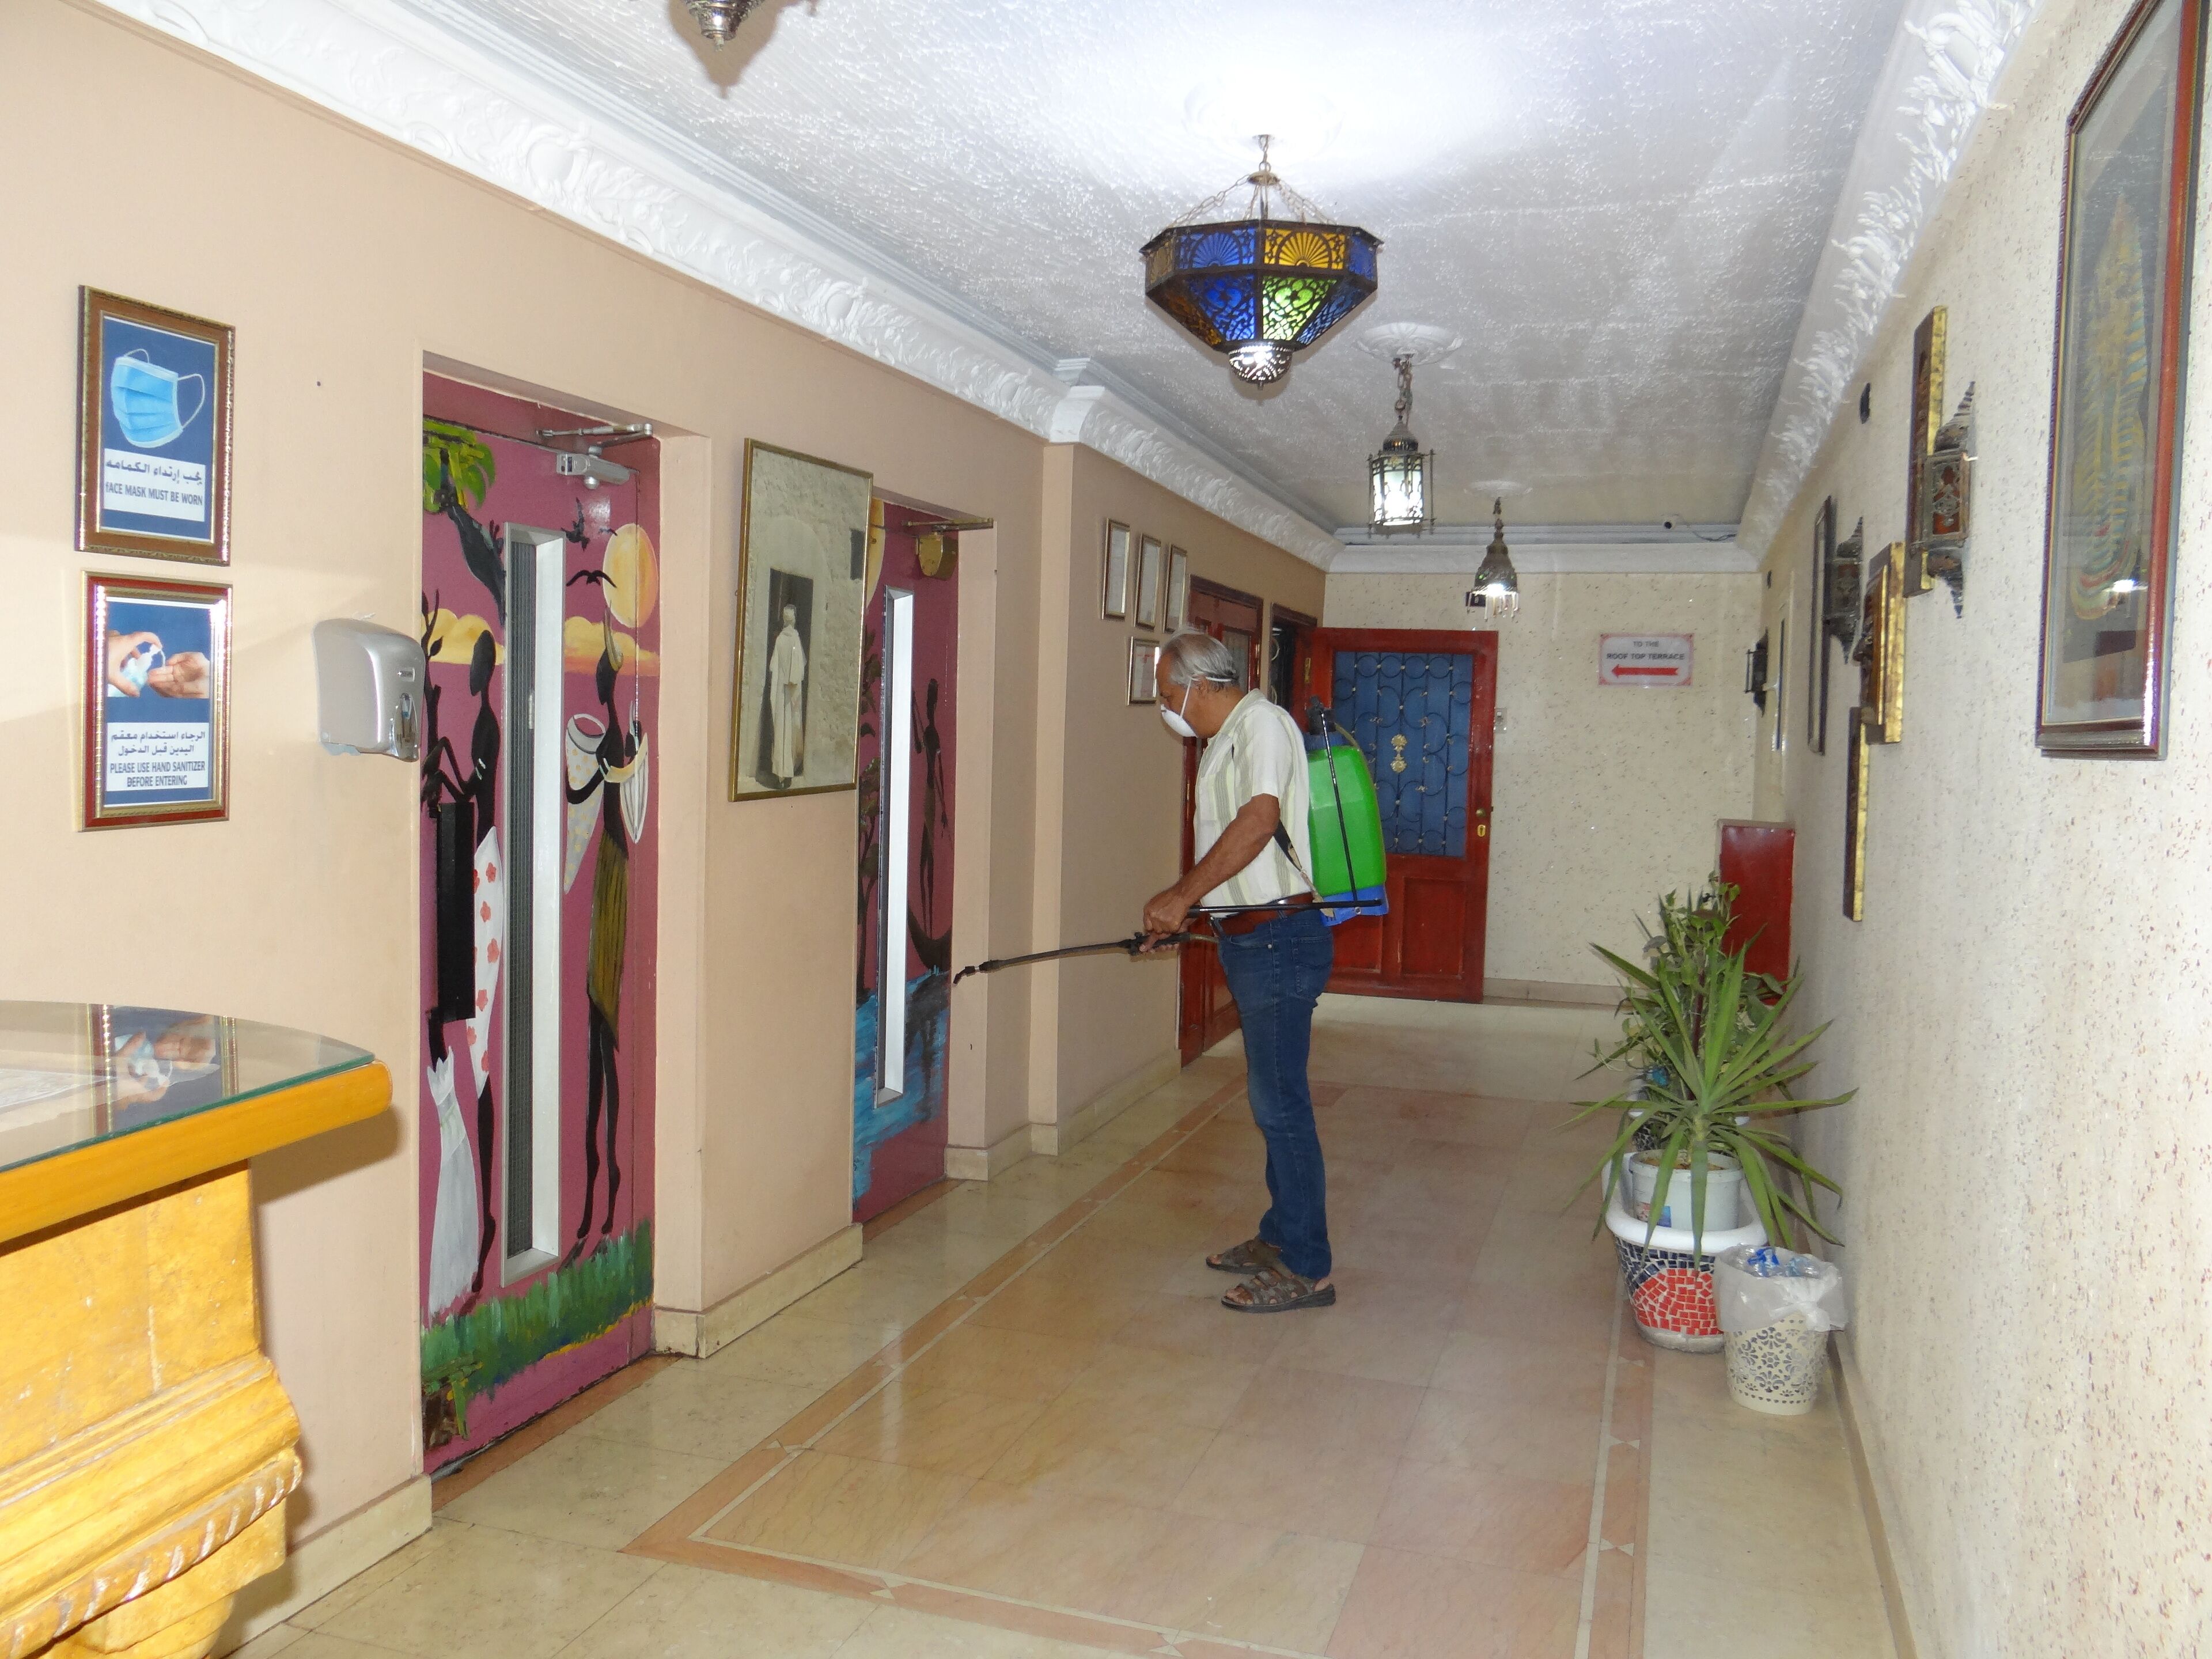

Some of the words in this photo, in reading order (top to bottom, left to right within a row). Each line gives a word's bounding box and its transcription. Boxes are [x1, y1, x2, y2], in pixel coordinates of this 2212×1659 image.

[125, 484, 146, 498] MASK
[149, 488, 169, 501] MUST
[171, 491, 179, 502] BE
[181, 493, 203, 505] WORN
[111, 729, 138, 743] معقم
[139, 729, 179, 743] استخدام
[181, 730, 206, 742] الرجاء
[118, 744, 150, 756] الدخول
[151, 742, 168, 756] قبل
[169, 744, 194, 756] اليدين
[110, 762, 135, 774] PLEASE
[137, 762, 150, 773] USE
[152, 761, 172, 772] HAND
[172, 760, 206, 772] SANITIZER
[127, 776, 153, 787] BEFORE
[155, 775, 188, 786] ENTERING
